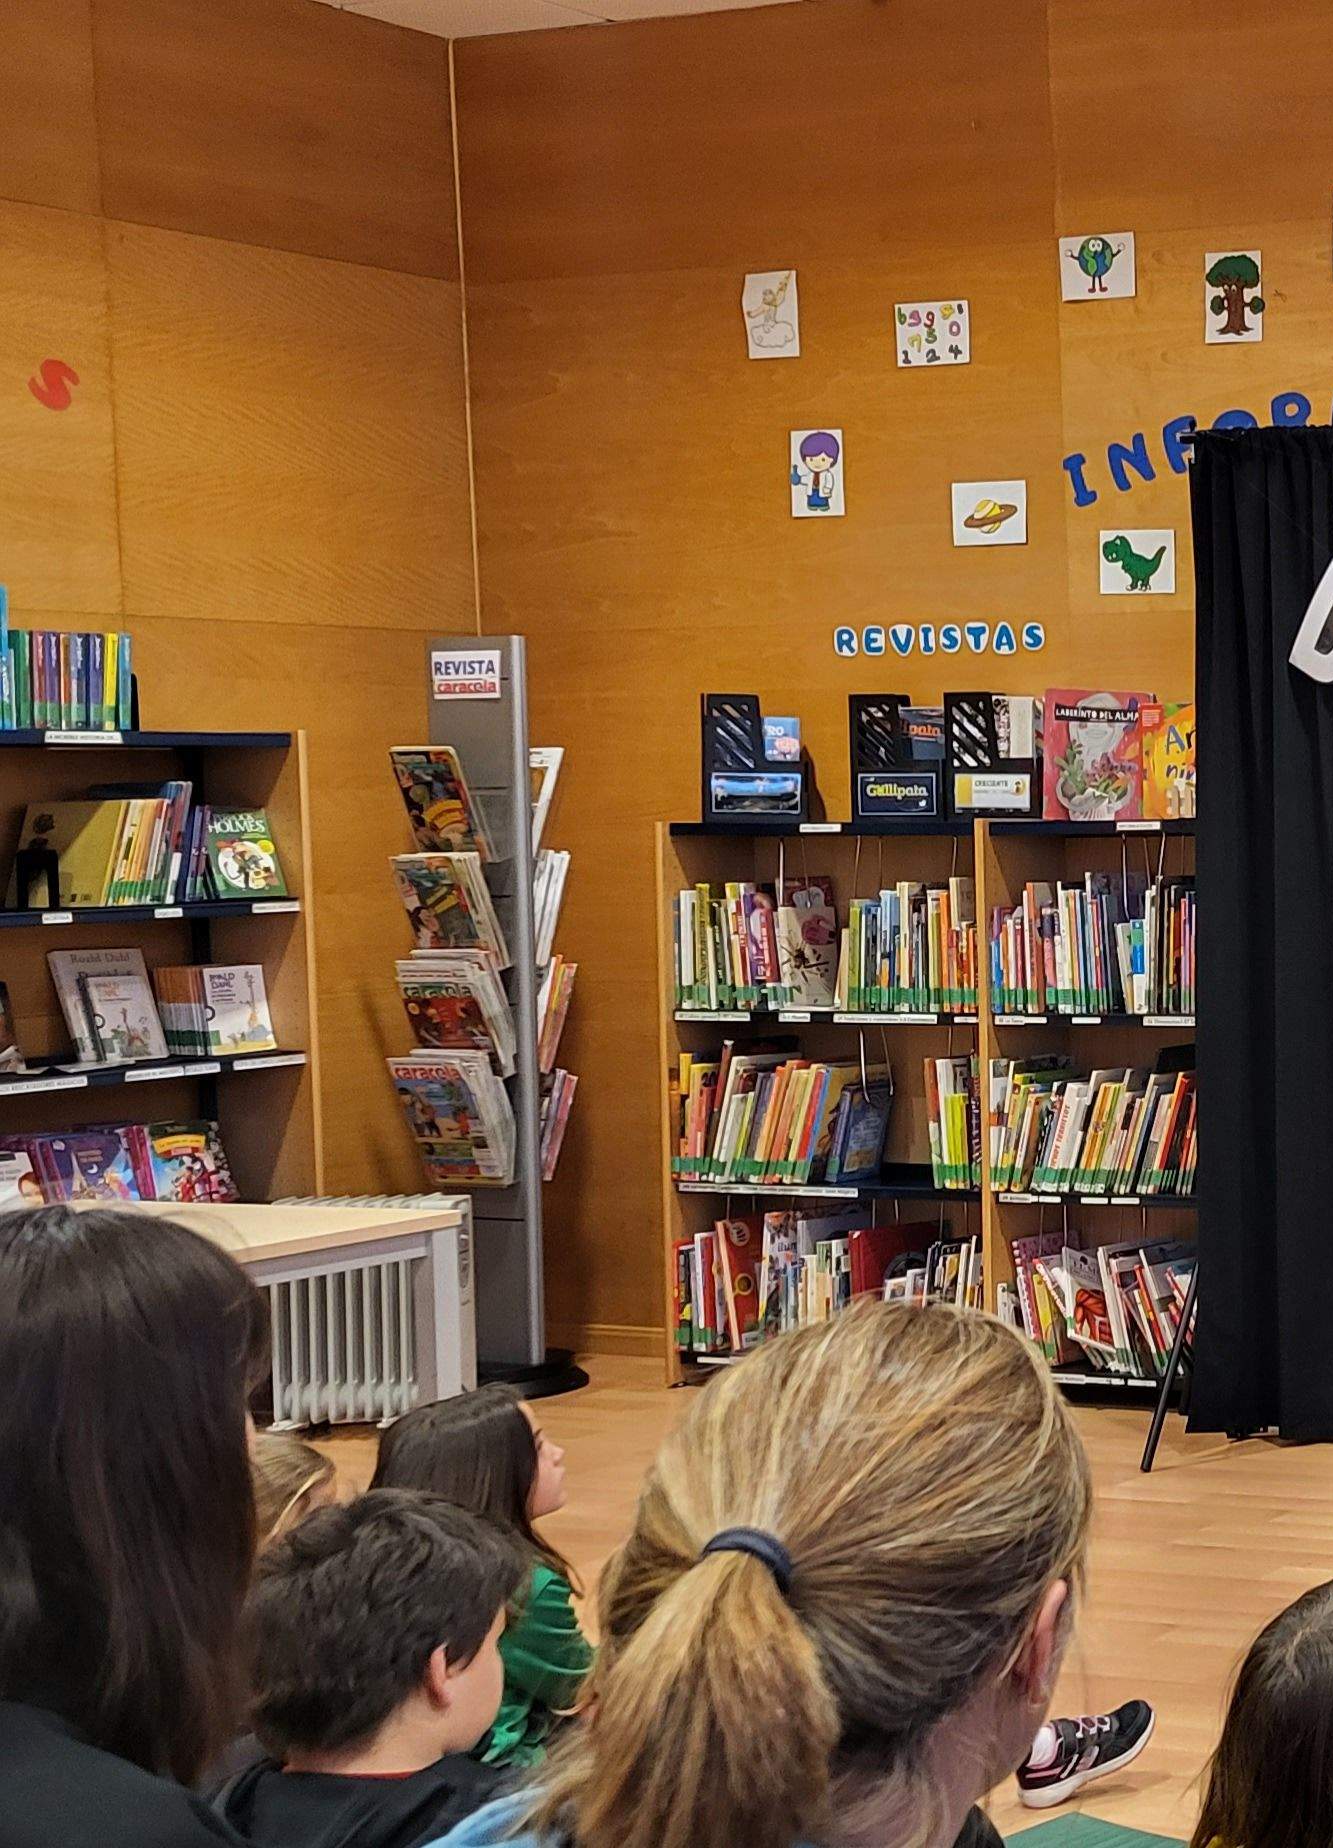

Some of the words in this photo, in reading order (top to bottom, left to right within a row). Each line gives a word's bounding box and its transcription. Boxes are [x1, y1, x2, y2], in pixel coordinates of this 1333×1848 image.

[834, 622, 1044, 655] REVISTAS
[433, 659, 496, 677] REVISTA
[436, 679, 497, 694] caracola
[1055, 707, 1097, 719] LABERINTO
[208, 819, 266, 834] HOLMES
